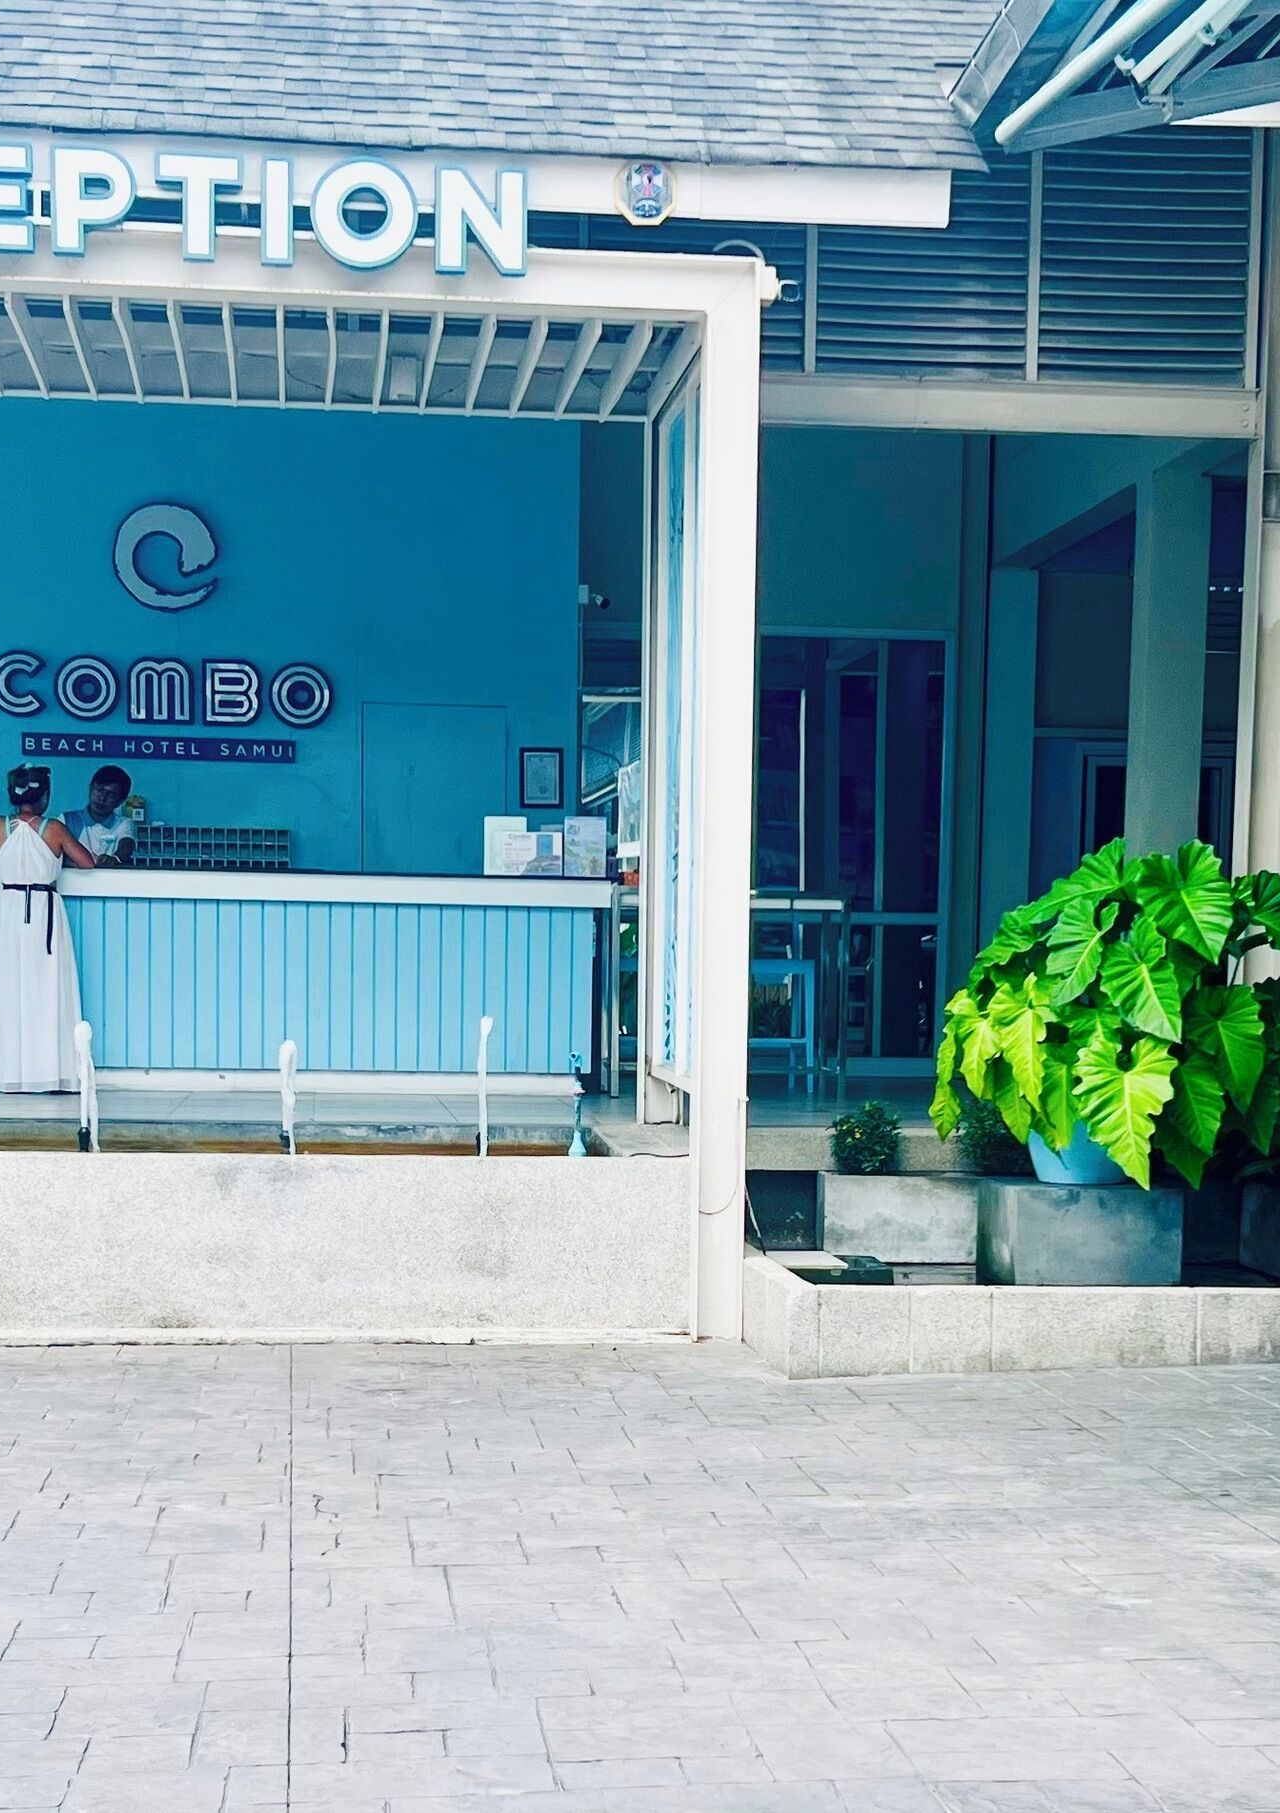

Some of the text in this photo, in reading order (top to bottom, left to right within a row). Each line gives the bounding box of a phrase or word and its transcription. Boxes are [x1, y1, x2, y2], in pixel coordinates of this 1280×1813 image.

[24, 737, 293, 758] BEACH HOTEL SAMUI
